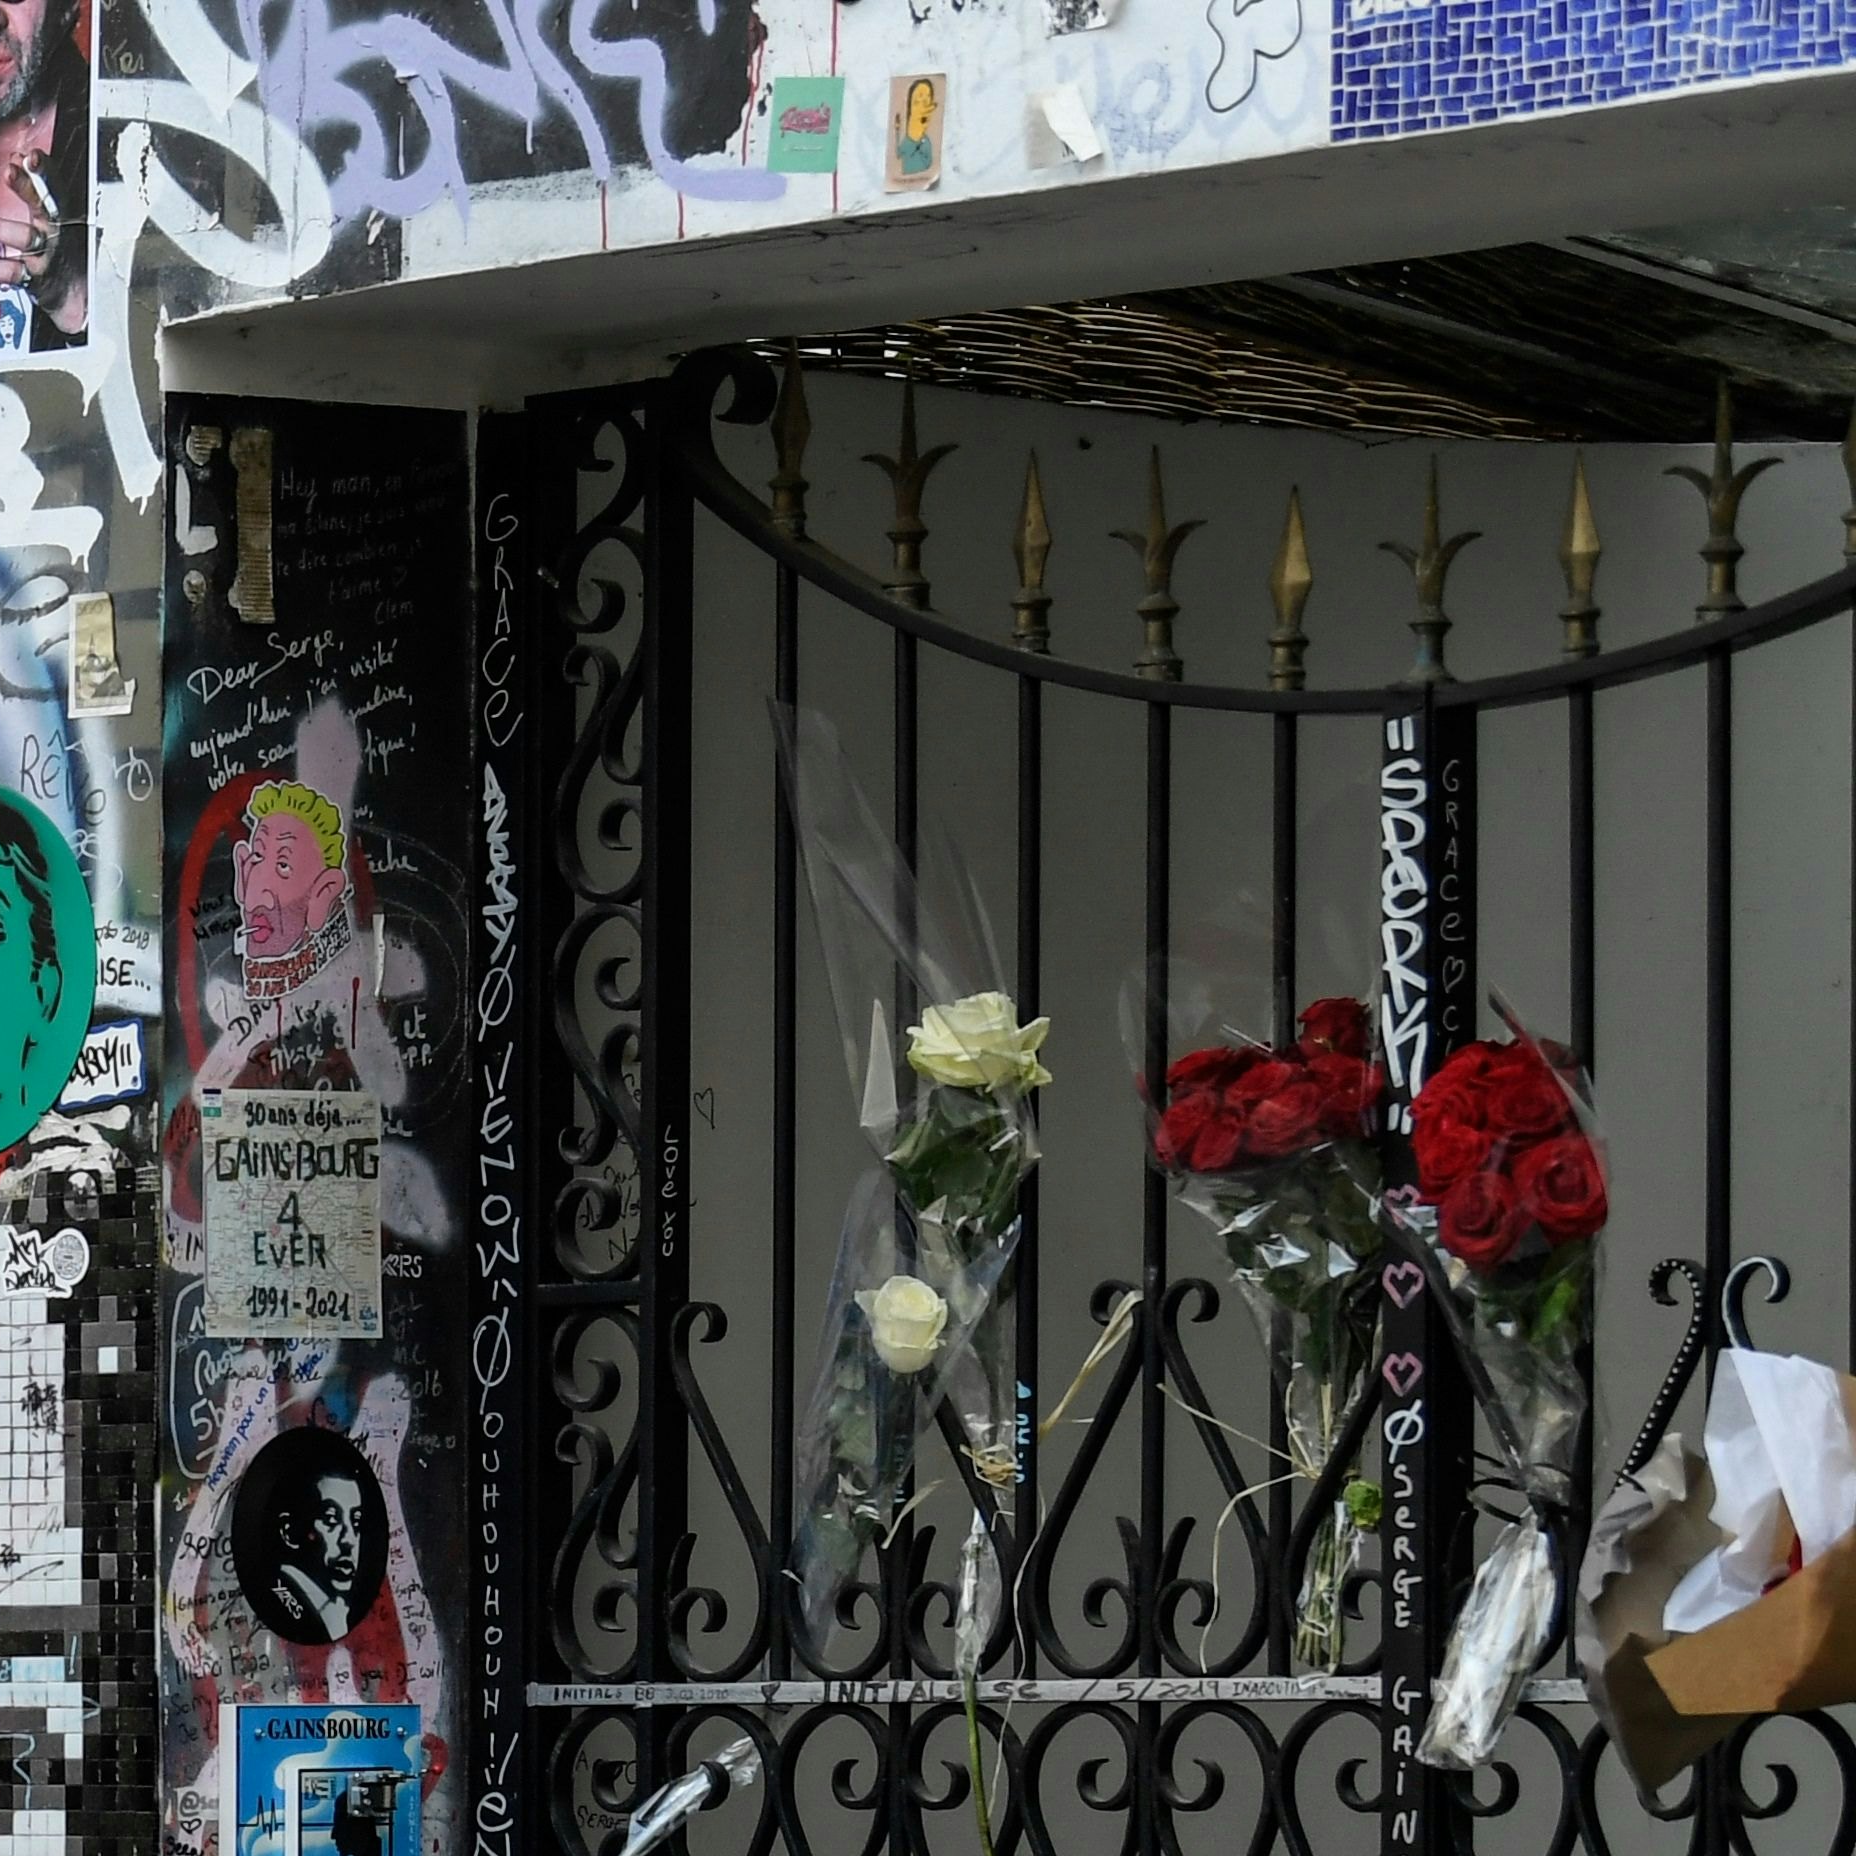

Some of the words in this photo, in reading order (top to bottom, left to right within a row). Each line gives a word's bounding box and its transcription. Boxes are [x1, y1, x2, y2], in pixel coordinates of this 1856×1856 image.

[187, 661, 260, 705] Dear
[249, 628, 344, 690] Serge,
[244, 1102, 268, 1128] 30
[267, 1106, 300, 1128] ans
[277, 1188, 302, 1231] 4
[244, 1282, 350, 1319] 1991-2021
[267, 1717, 392, 1740] GAINSBOURG
